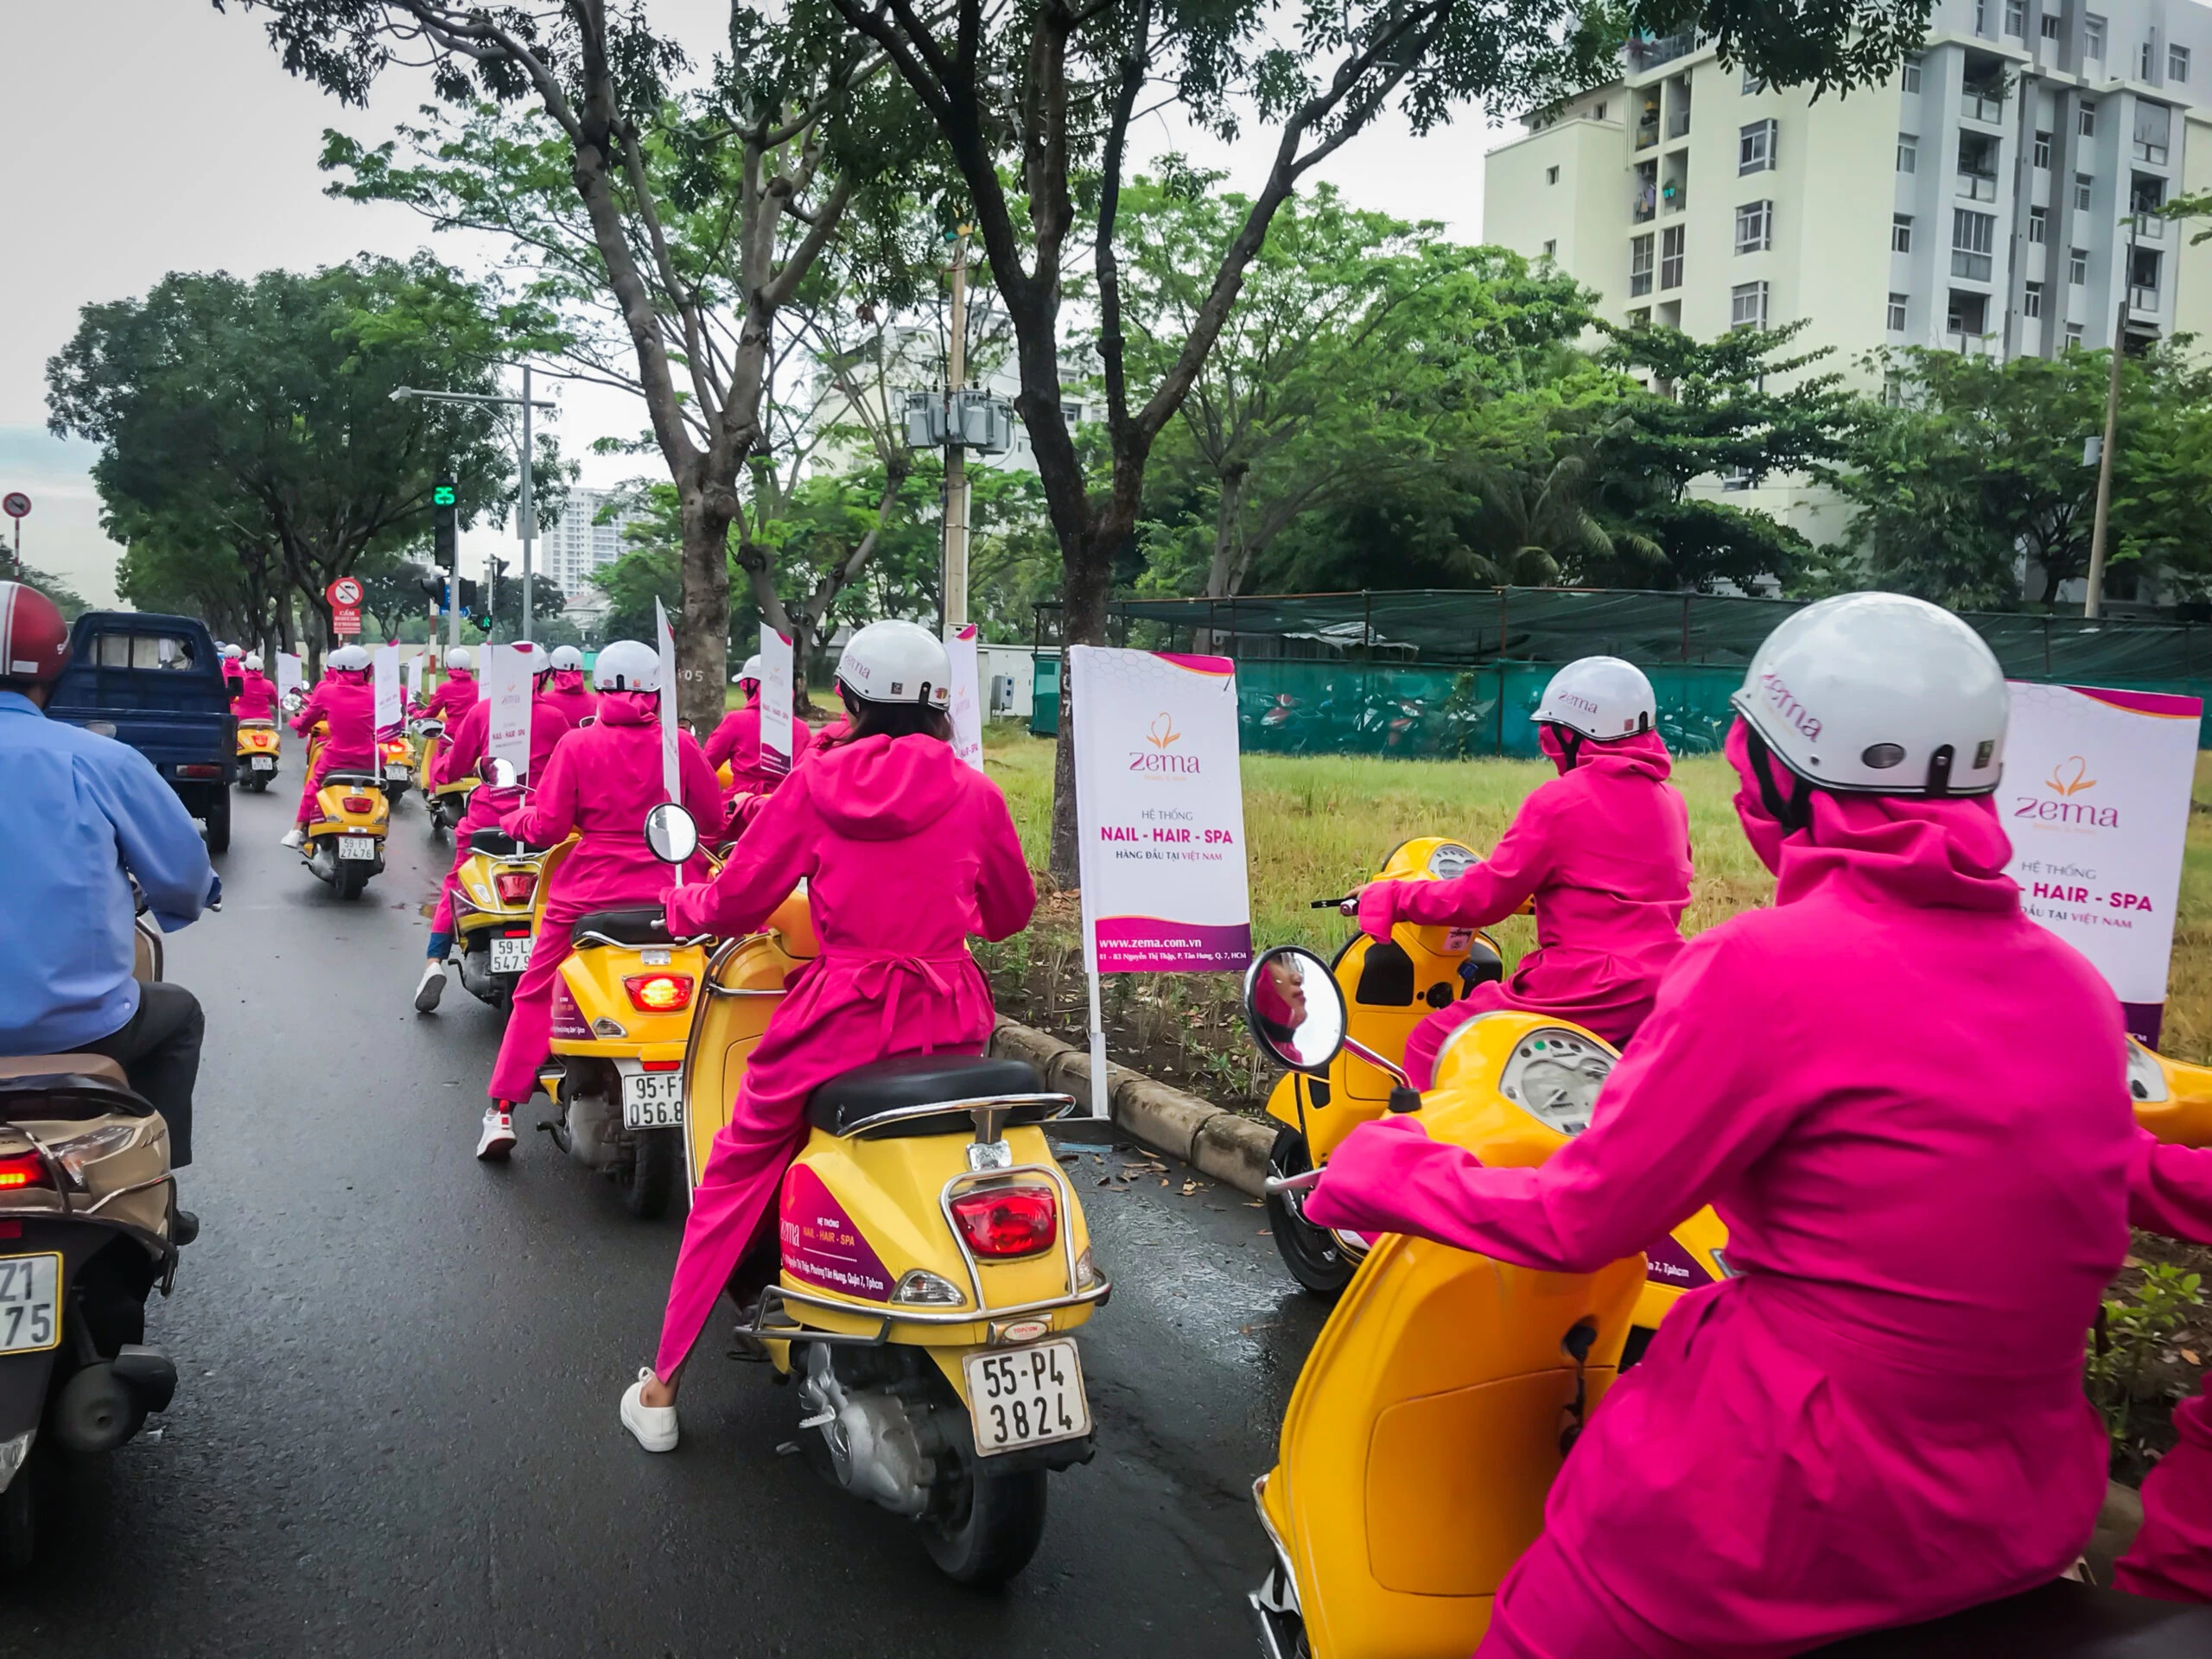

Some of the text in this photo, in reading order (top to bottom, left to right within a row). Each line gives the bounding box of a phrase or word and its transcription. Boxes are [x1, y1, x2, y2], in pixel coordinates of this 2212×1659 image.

[845, 655, 871, 680] ema
[1558, 690, 1599, 715] zema
[1128, 752, 1201, 774] zema
[1141, 808, 1194, 821] HỆ THỐNG
[2013, 797, 2120, 829] zema
[1101, 827, 1139, 842] NAIL
[1153, 828, 1191, 843] HAIR
[1204, 830, 1234, 844] SPA
[1116, 849, 1143, 860] HÀNG
[1166, 851, 1179, 861] TẠI
[1182, 850, 1200, 861] VIỆT
[1203, 852, 1223, 861] NAM
[2046, 863, 2097, 880] THỐNG
[2033, 881, 2088, 904] HAIR
[2109, 892, 2153, 912] SPA
[2048, 910, 2068, 921] TẠI
[2071, 912, 2099, 925] VIỆT
[2103, 918, 2133, 929] NAM
[499, 940, 531, 955] 59-L
[1099, 938, 1202, 948] www.zema.com.vn
[636, 1076, 683, 1099] 95-F
[803, 1226, 815, 1238] NAIL
[819, 1230, 835, 1243] HAIR
[840, 1234, 855, 1246] SPA
[5, 1303, 51, 1347] 75
[982, 1348, 1065, 1398] 55-P4
[990, 1392, 1073, 1443] 3824
